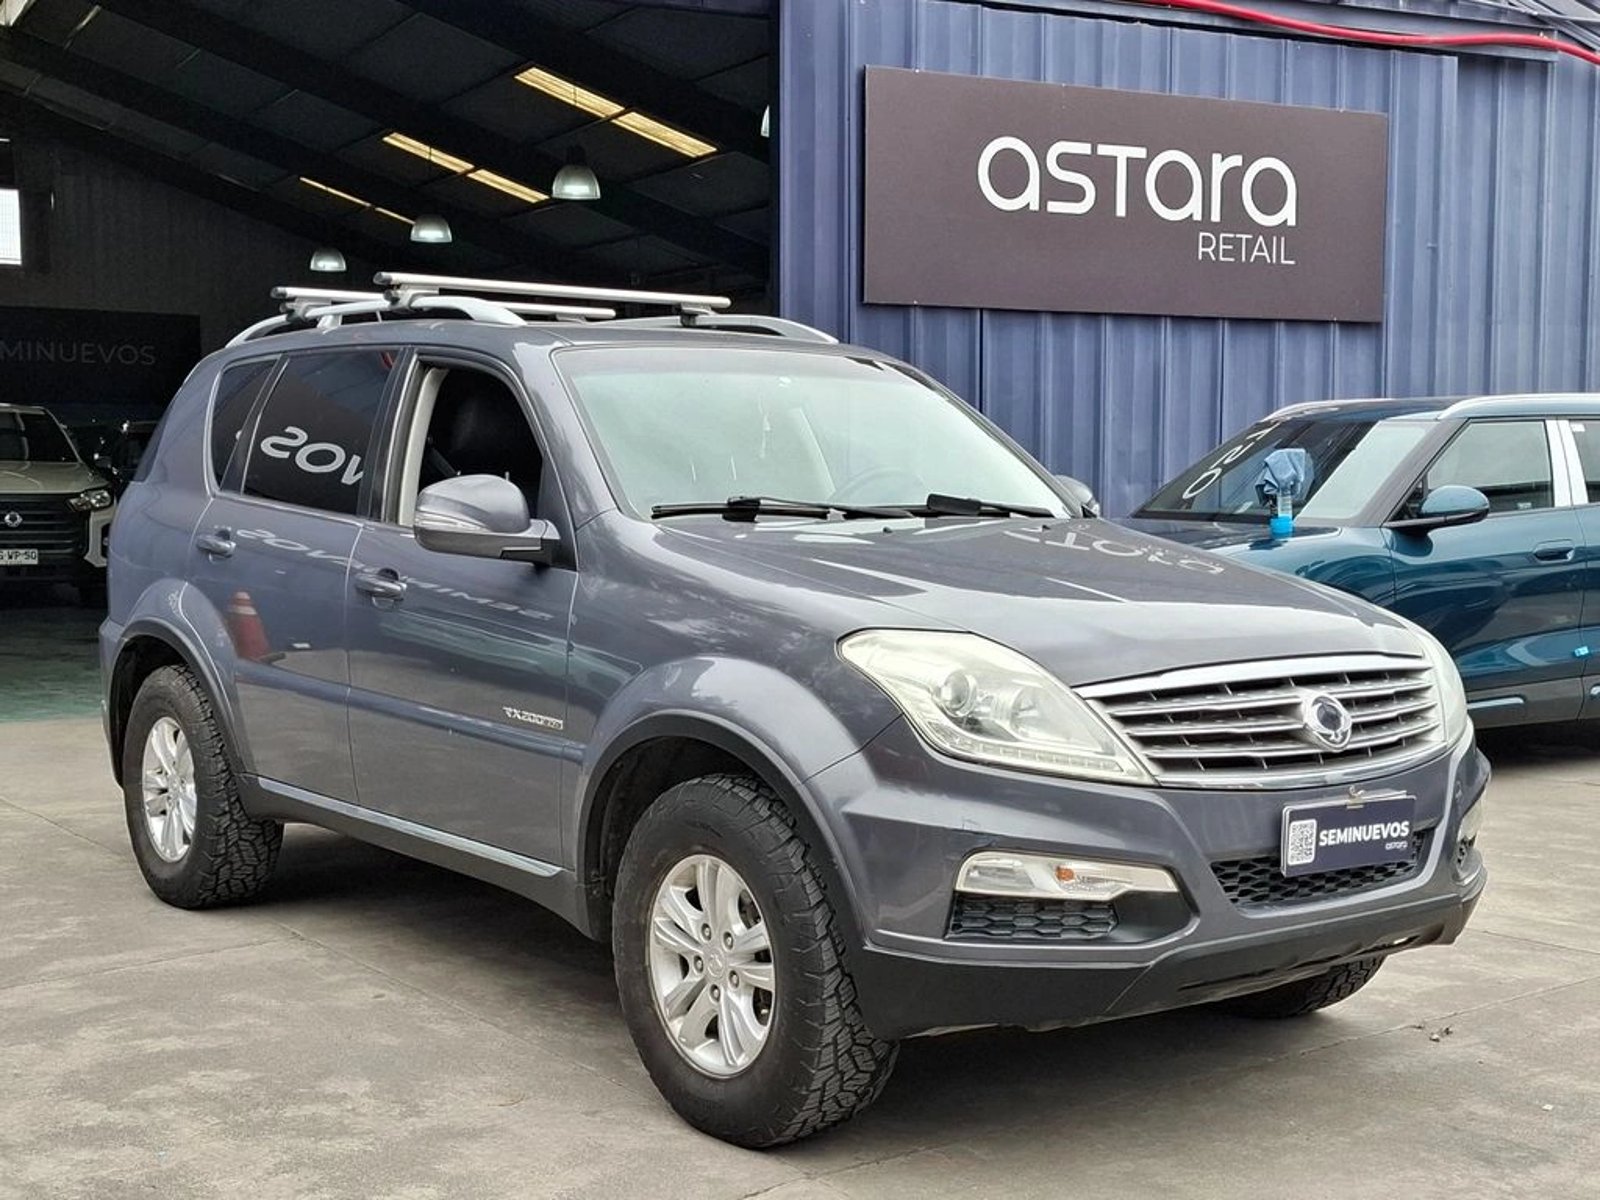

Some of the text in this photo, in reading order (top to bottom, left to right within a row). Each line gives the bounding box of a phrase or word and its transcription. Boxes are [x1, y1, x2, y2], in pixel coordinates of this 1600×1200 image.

[977, 135, 1298, 227] astara
[1198, 231, 1296, 265] RETAIL
[1318, 820, 1410, 846] SEMINUEVOS
